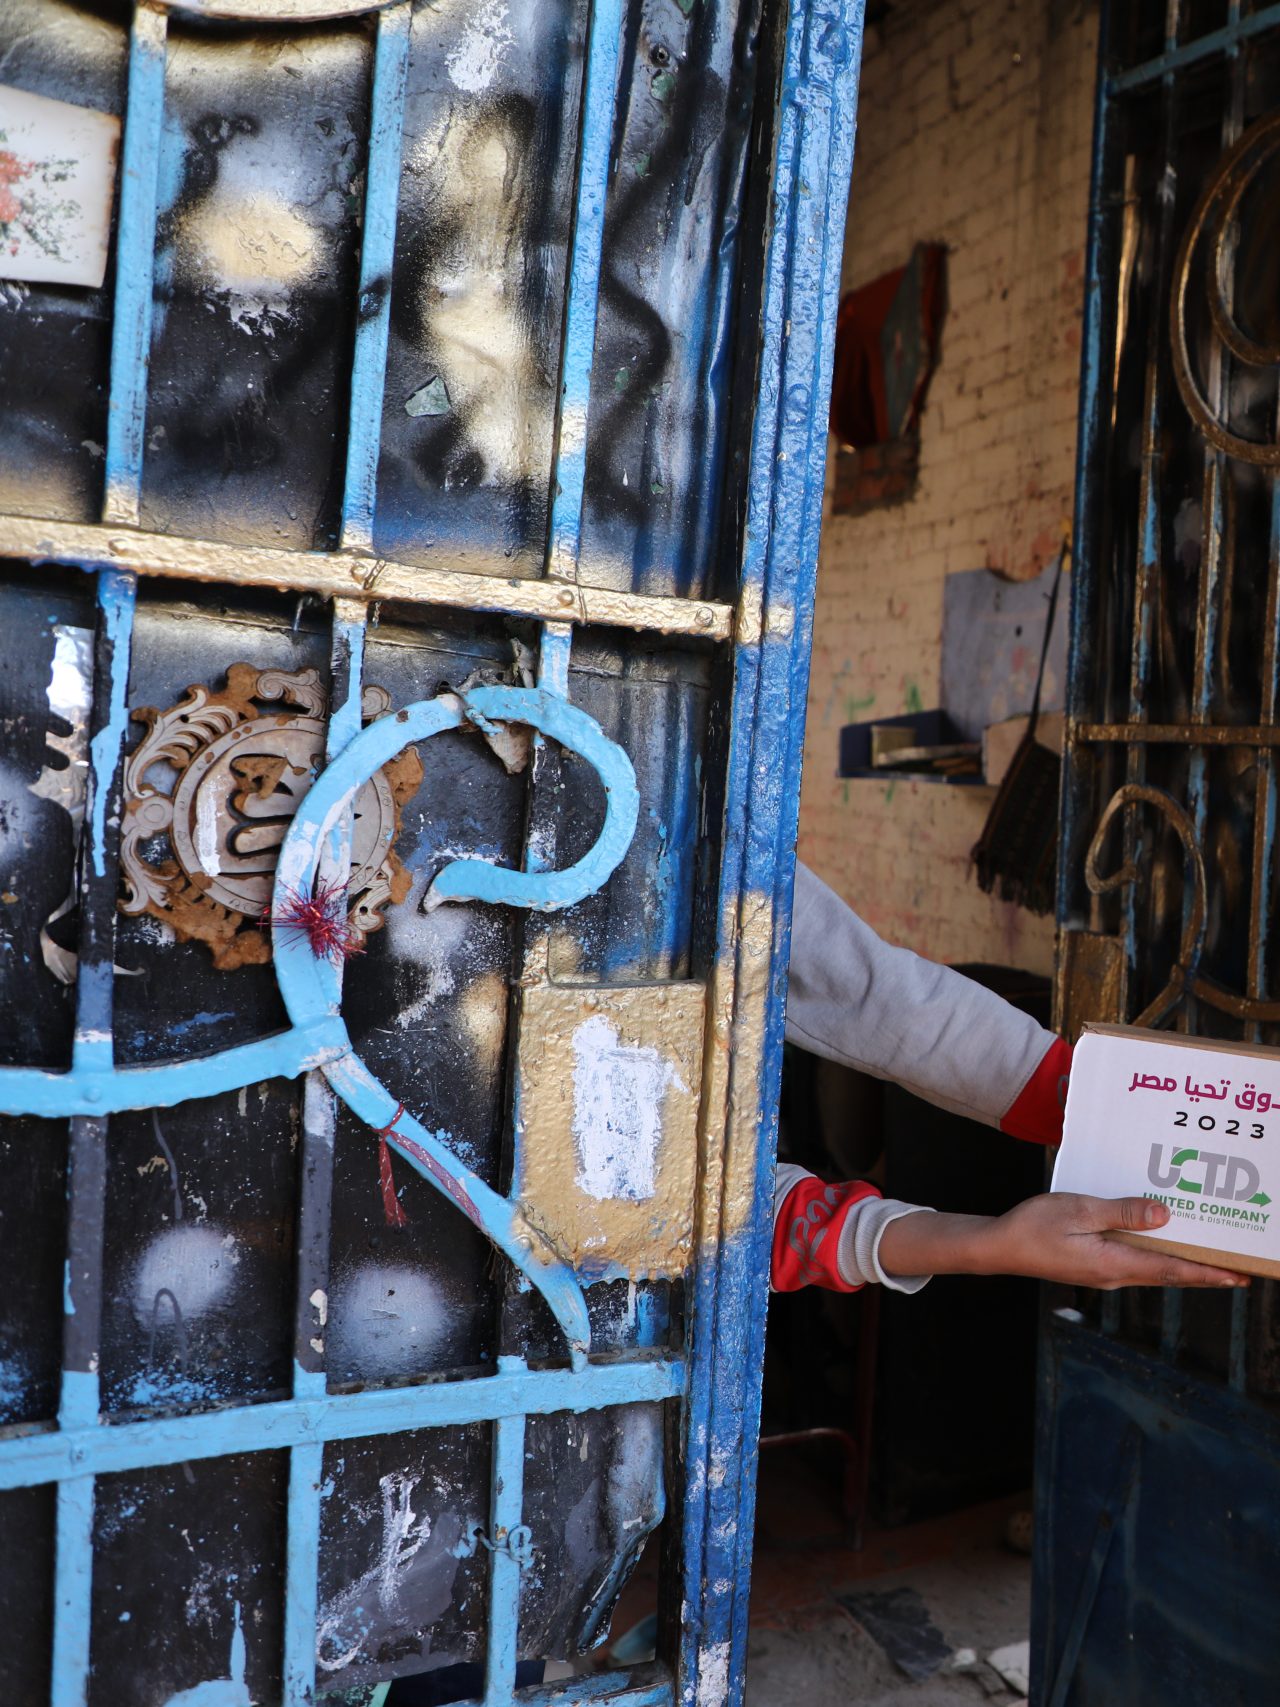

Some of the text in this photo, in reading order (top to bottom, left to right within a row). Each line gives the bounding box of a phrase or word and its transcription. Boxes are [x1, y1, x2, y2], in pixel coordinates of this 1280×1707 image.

[1128, 1072, 1178, 1092] مصر
[1184, 1075, 1231, 1103] تحيا
[1173, 1111, 1265, 1139] 2023
[1199, 1203, 1270, 1224] COMPANY
[1207, 1216, 1266, 1232] DISTRIBUTION
